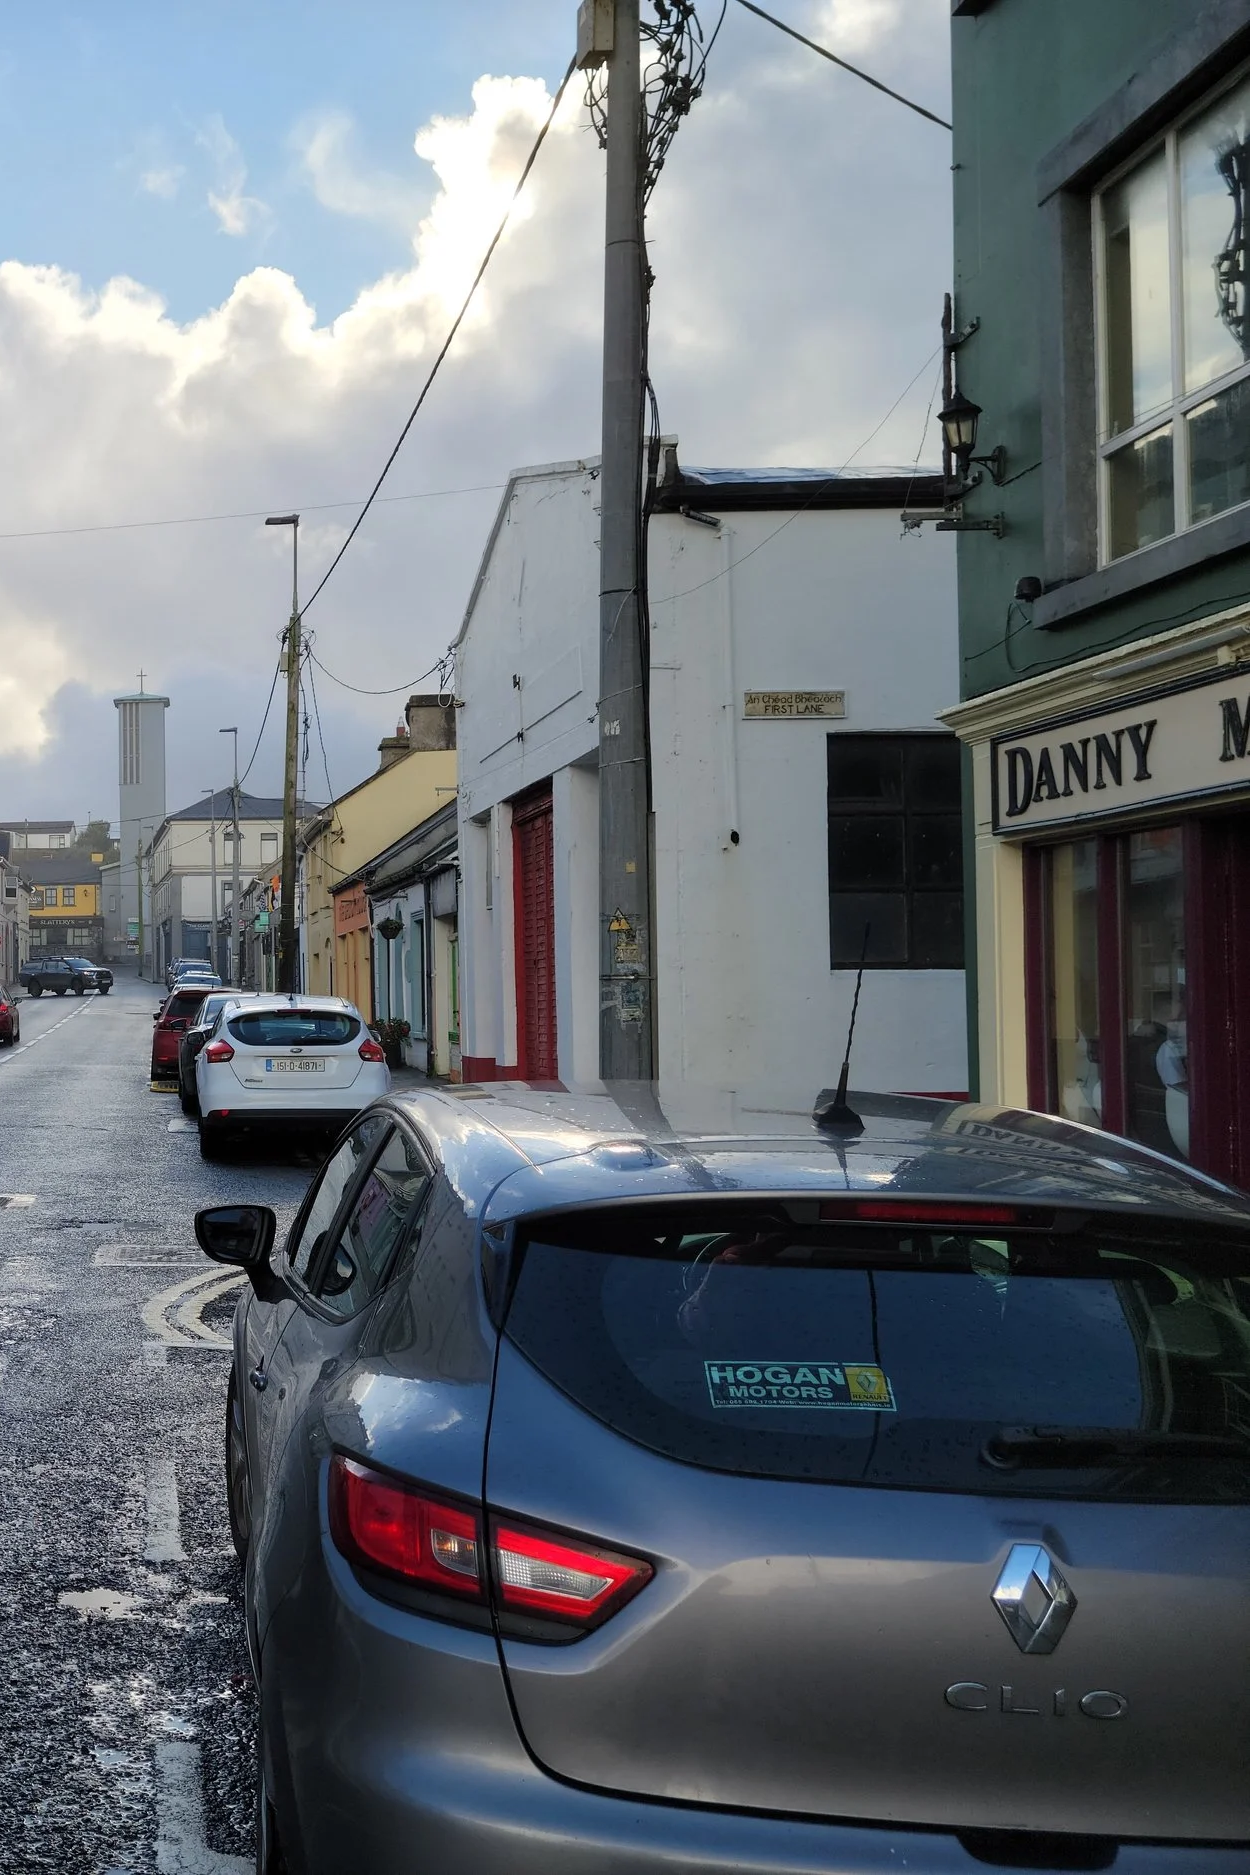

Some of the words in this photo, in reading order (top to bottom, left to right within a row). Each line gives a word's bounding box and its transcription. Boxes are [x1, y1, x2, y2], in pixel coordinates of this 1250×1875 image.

[764, 704, 794, 714] FIRST
[796, 704, 825, 714] LANE
[1005, 719, 1158, 818] DANNY
[710, 1366, 846, 1385] HOGAN
[728, 1386, 833, 1399] MOTORS
[851, 1394, 889, 1402] RENAULT
[944, 1681, 1129, 1719] CLIO
